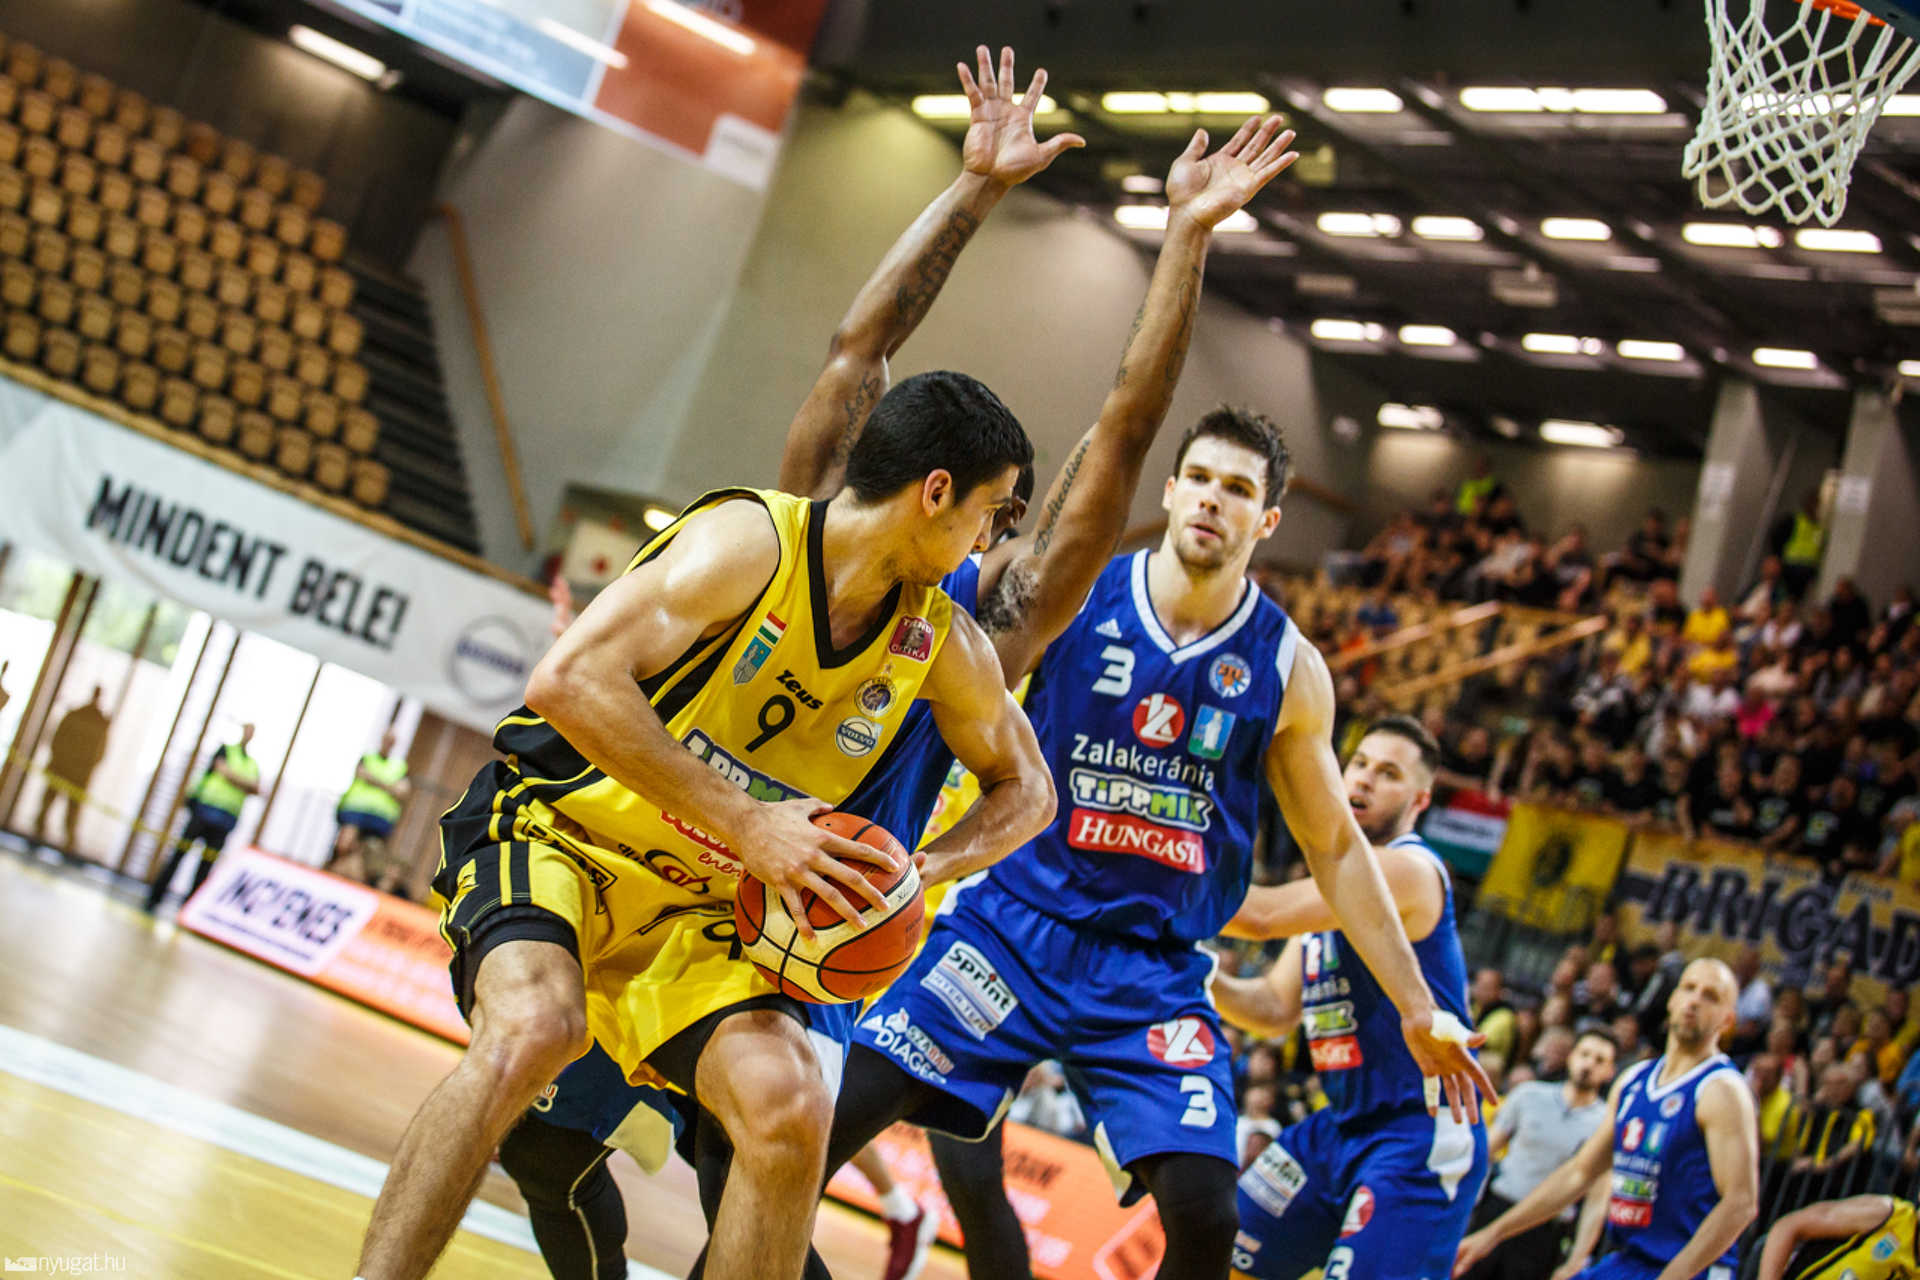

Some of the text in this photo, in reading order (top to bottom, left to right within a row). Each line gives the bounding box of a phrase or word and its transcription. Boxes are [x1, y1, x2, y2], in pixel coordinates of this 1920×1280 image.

[86, 475, 409, 650] MINDENT BELE!
[1092, 645, 1135, 697] 3
[745, 695, 796, 753] 9
[839, 725, 876, 747] VOLVO
[698, 850, 745, 878] ener
[1077, 815, 1200, 868] HUNGAST
[949, 948, 1013, 1011] Sprint
[1179, 1075, 1217, 1129] 3
